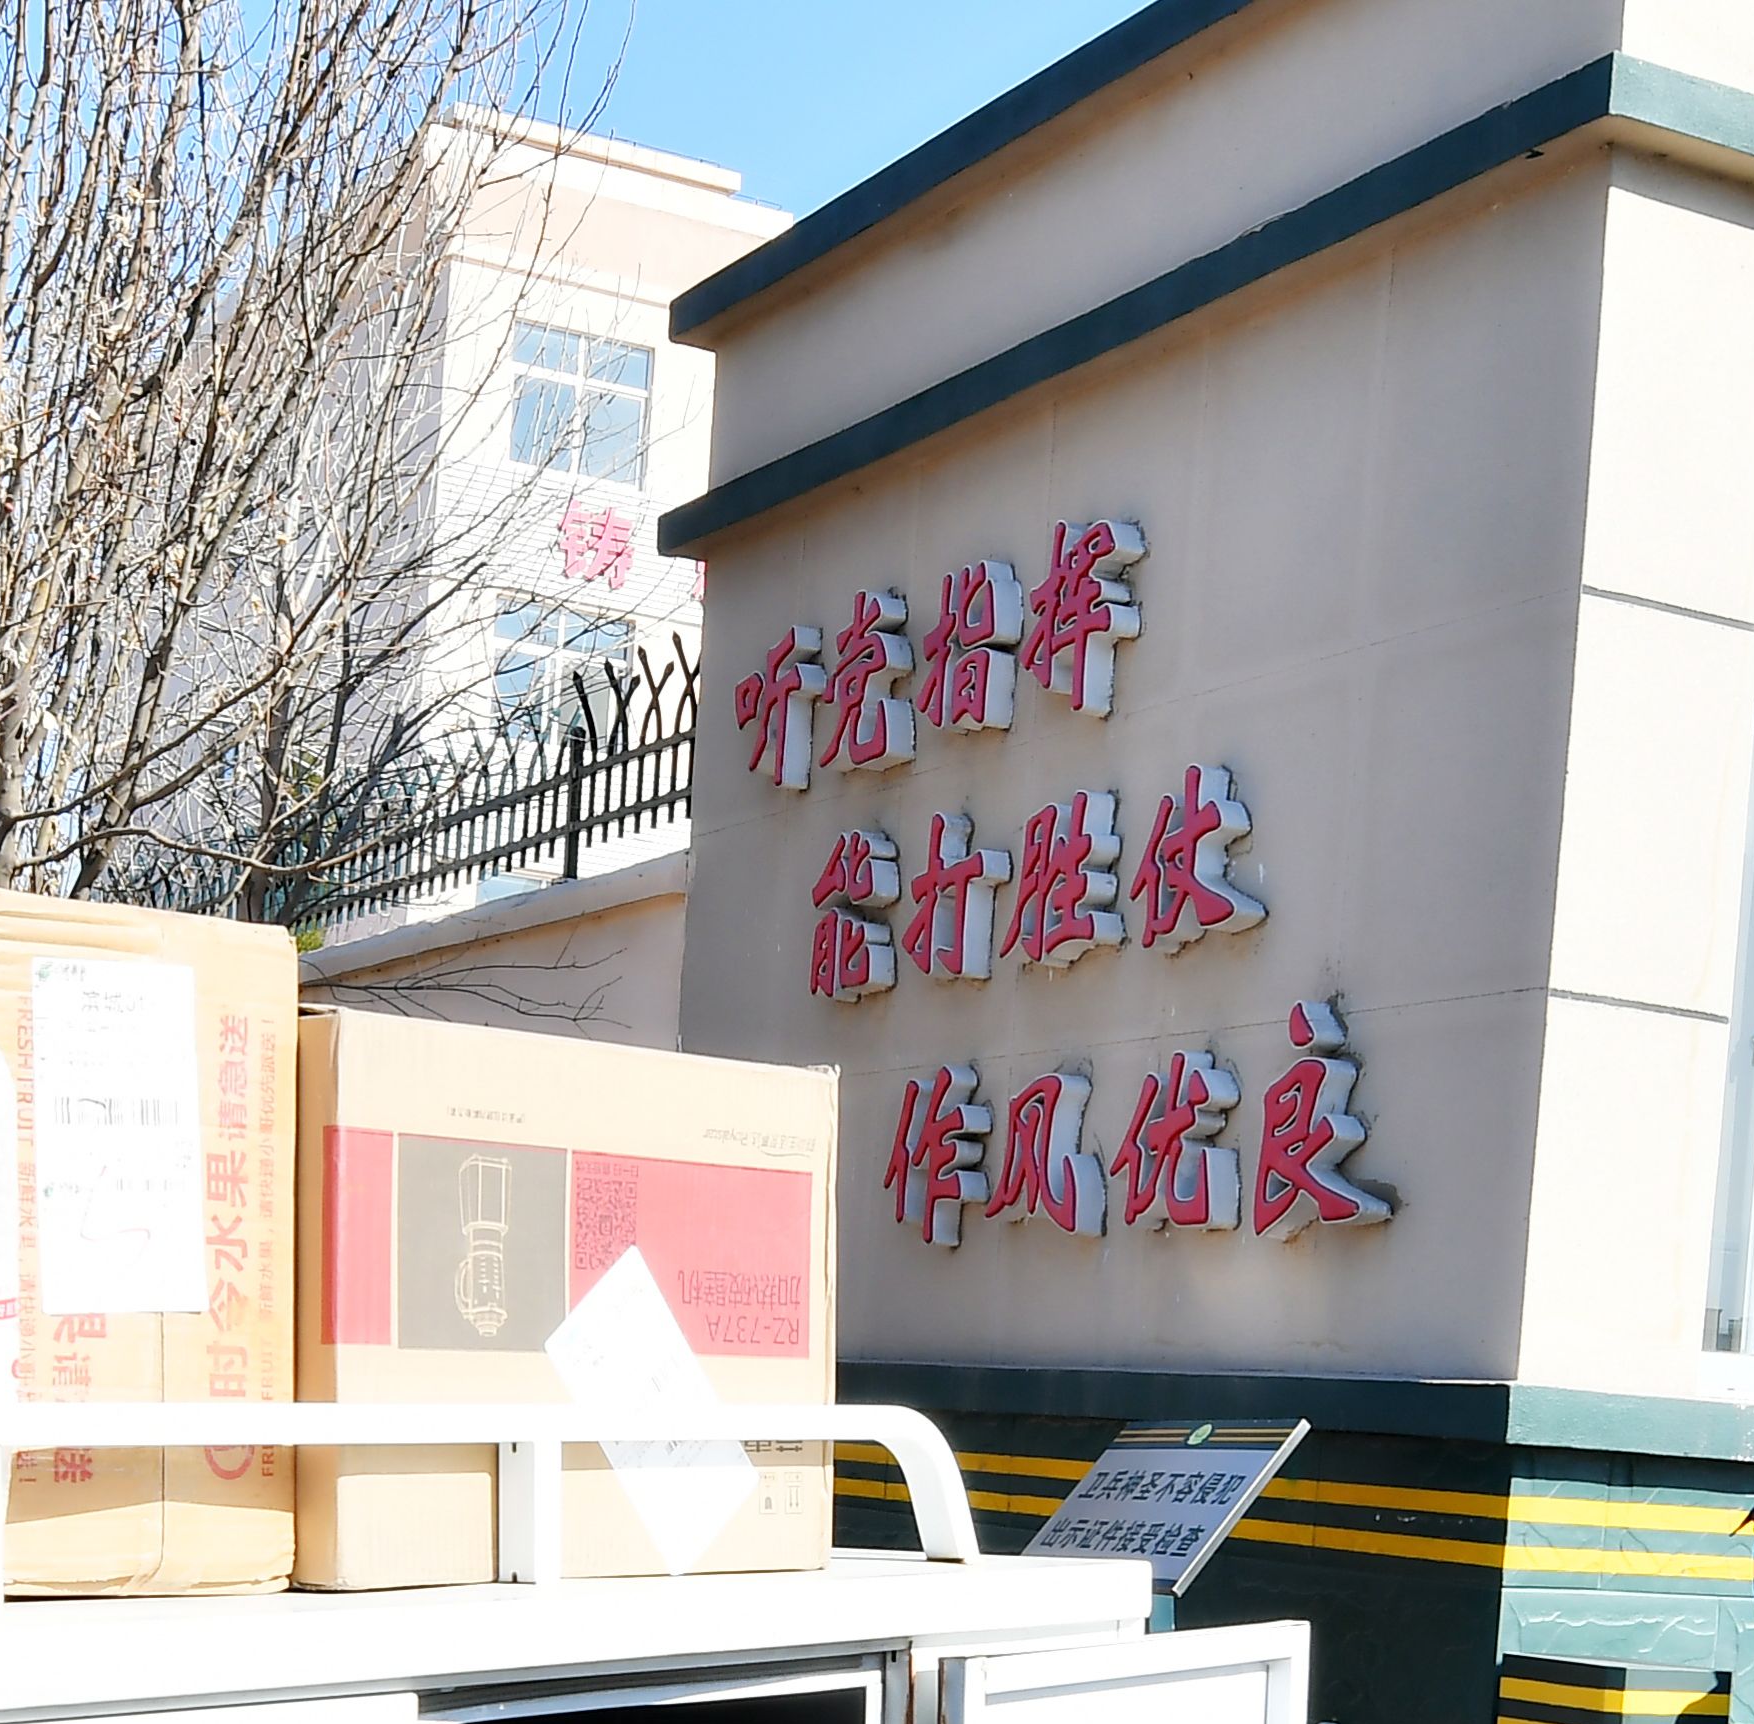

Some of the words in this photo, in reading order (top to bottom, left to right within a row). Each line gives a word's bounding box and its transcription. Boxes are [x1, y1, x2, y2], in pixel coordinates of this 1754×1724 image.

[556, 498, 636, 591] 铸
[734, 519, 1138, 789] 听党指挥
[809, 763, 1257, 1000] 能打胜仗
[216, 1014, 249, 1141] 请急送
[883, 1001, 1380, 1247] 作风优良
[206, 1151, 249, 1398] 时令水果
[676, 1269, 802, 1311] 加热破壁机
[705, 1314, 801, 1345] RZ-737A
[1039, 1516, 1206, 1558] 出示证件接受检查
[1077, 1470, 1248, 1505] 卫兵神圣不容侵犯
